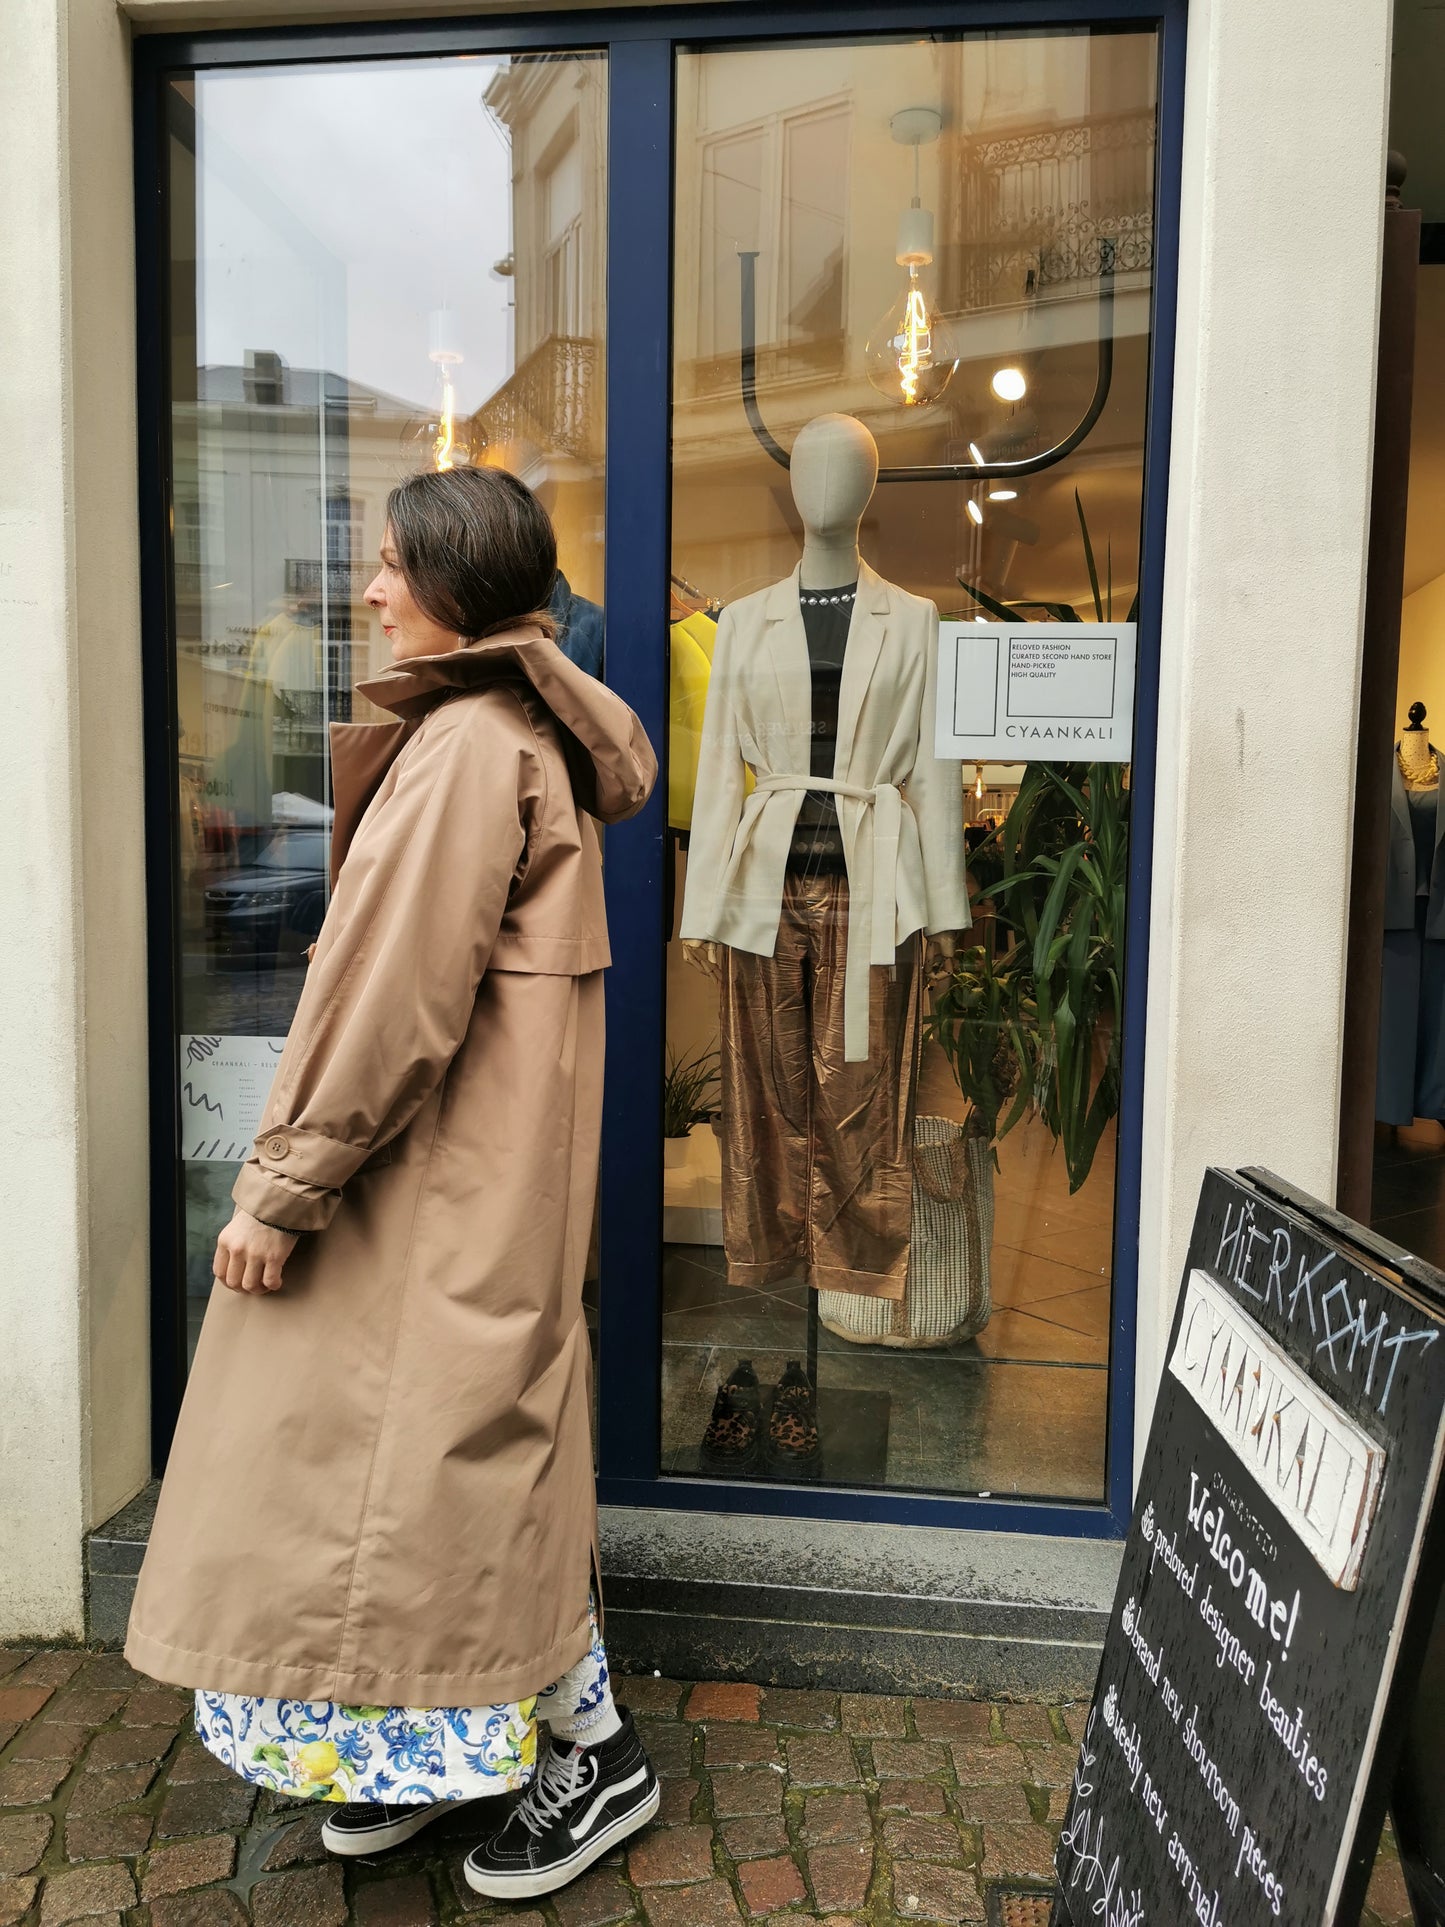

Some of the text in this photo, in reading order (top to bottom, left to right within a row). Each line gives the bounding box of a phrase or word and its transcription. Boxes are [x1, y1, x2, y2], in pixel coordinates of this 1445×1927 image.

[1005, 725, 1113, 740] CYAANKALI
[1149, 1528, 1199, 1599] preloved
[1200, 1584, 1255, 1685] designer
[1259, 1660, 1328, 1801] beauties
[1188, 1471, 1300, 1662] Welcome!
[1113, 1709, 1223, 1927] weekly new arrival
[1131, 1606, 1284, 1916] brand new showroom pieces
